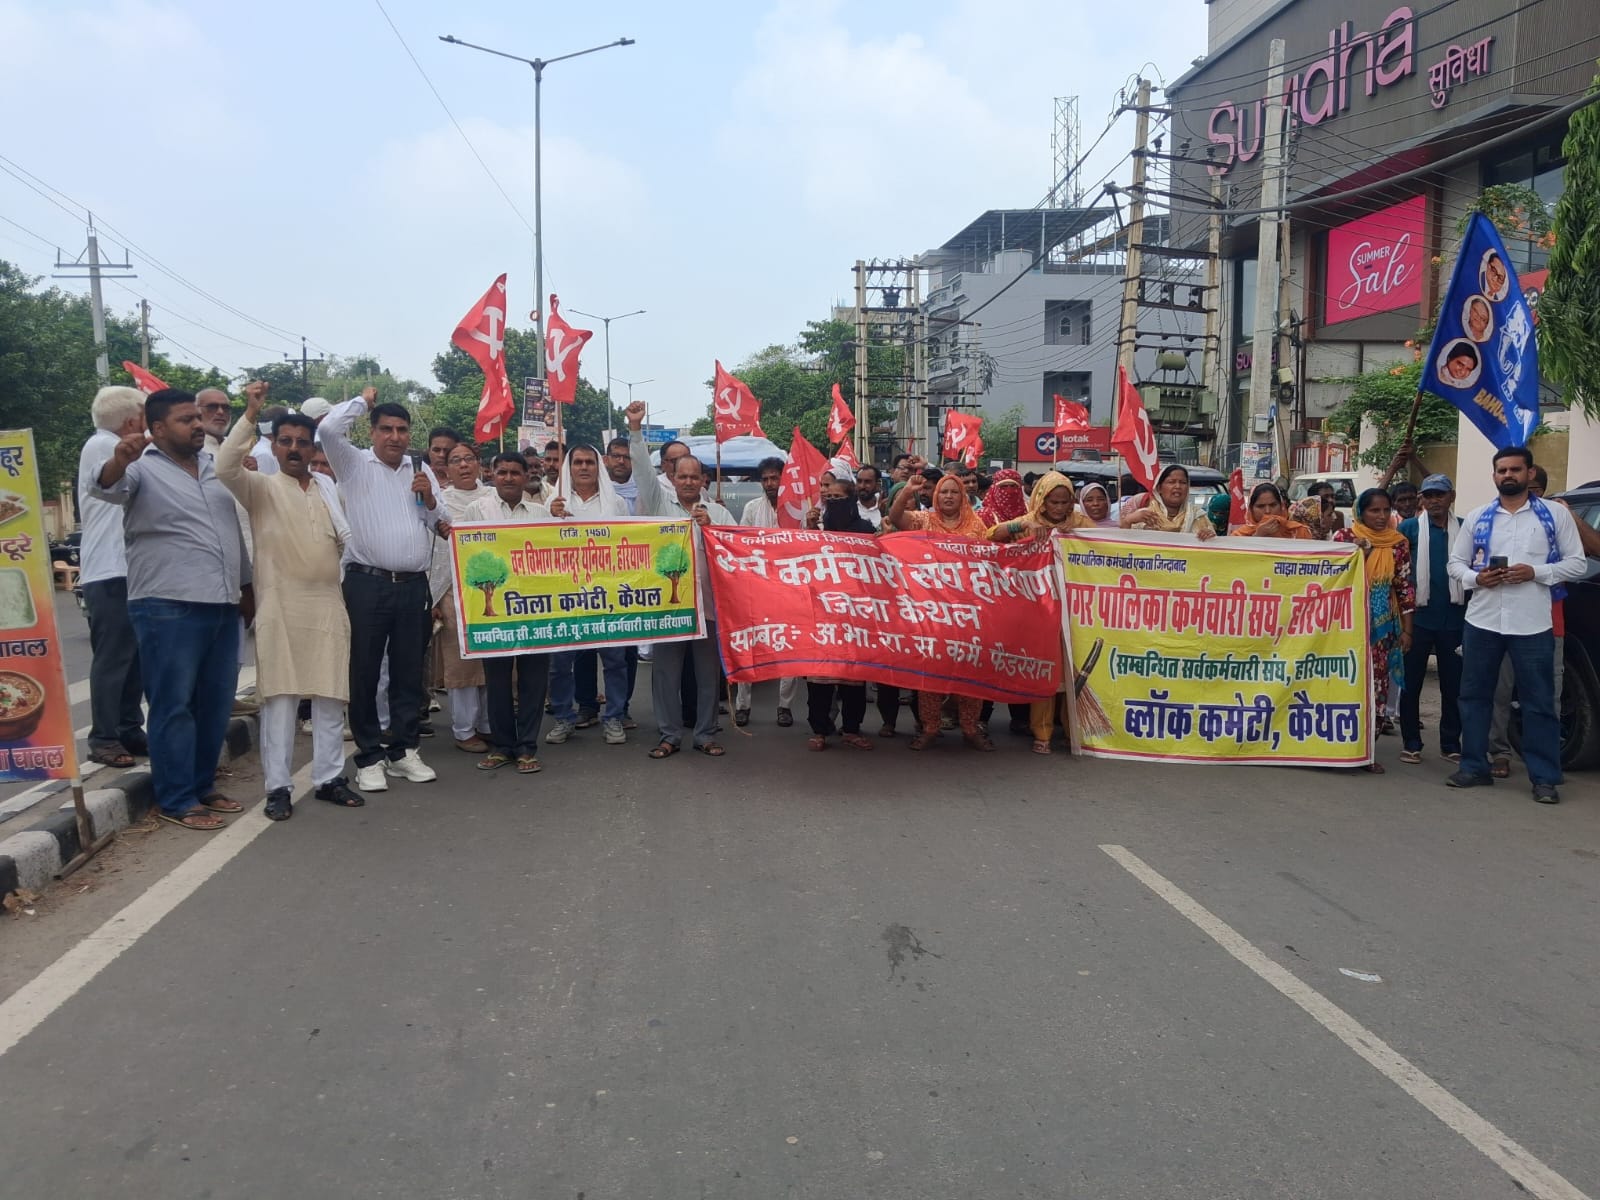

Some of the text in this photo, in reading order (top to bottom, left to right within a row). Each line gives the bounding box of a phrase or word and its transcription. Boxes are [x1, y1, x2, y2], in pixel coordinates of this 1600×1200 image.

[1428, 36, 1495, 109] सुविधा
[1339, 233, 1415, 309] Sale
[1356, 245, 1391, 266] SUMMER
[1062, 434, 1089, 443] kotak
[616, 536, 651, 572] हरियाणा
[741, 529, 794, 545] कर्मचारी
[795, 530, 820, 542] संघ
[774, 545, 909, 590] कर्मचारी
[907, 552, 965, 592] संघ
[1081, 549, 1105, 568] पालिका
[1134, 557, 1153, 572] एकता
[1154, 554, 1188, 574] जिन्दाबाद
[503, 583, 662, 617] जिला कमेटी, कैथल
[816, 591, 982, 630] जिला कैथल
[1098, 574, 1171, 633] पालिका
[1172, 576, 1248, 637] कर्मचारी
[1248, 578, 1283, 646] संघ,
[1286, 583, 1353, 636] हरियाणा
[472, 627, 514, 644] सम्बन्धित
[607, 615, 642, 633] कर्मचारी
[643, 615, 658, 631] संघ
[659, 614, 693, 630] हरियाणा
[1109, 647, 1181, 680] (सम्बन्धित
[1262, 653, 1291, 687] संघ,
[1294, 649, 1357, 684] हरियाणा)
[1124, 689, 1361, 750] ब्लॉक कमेटी, कैथल
[12, 744, 65, 769] चावल
